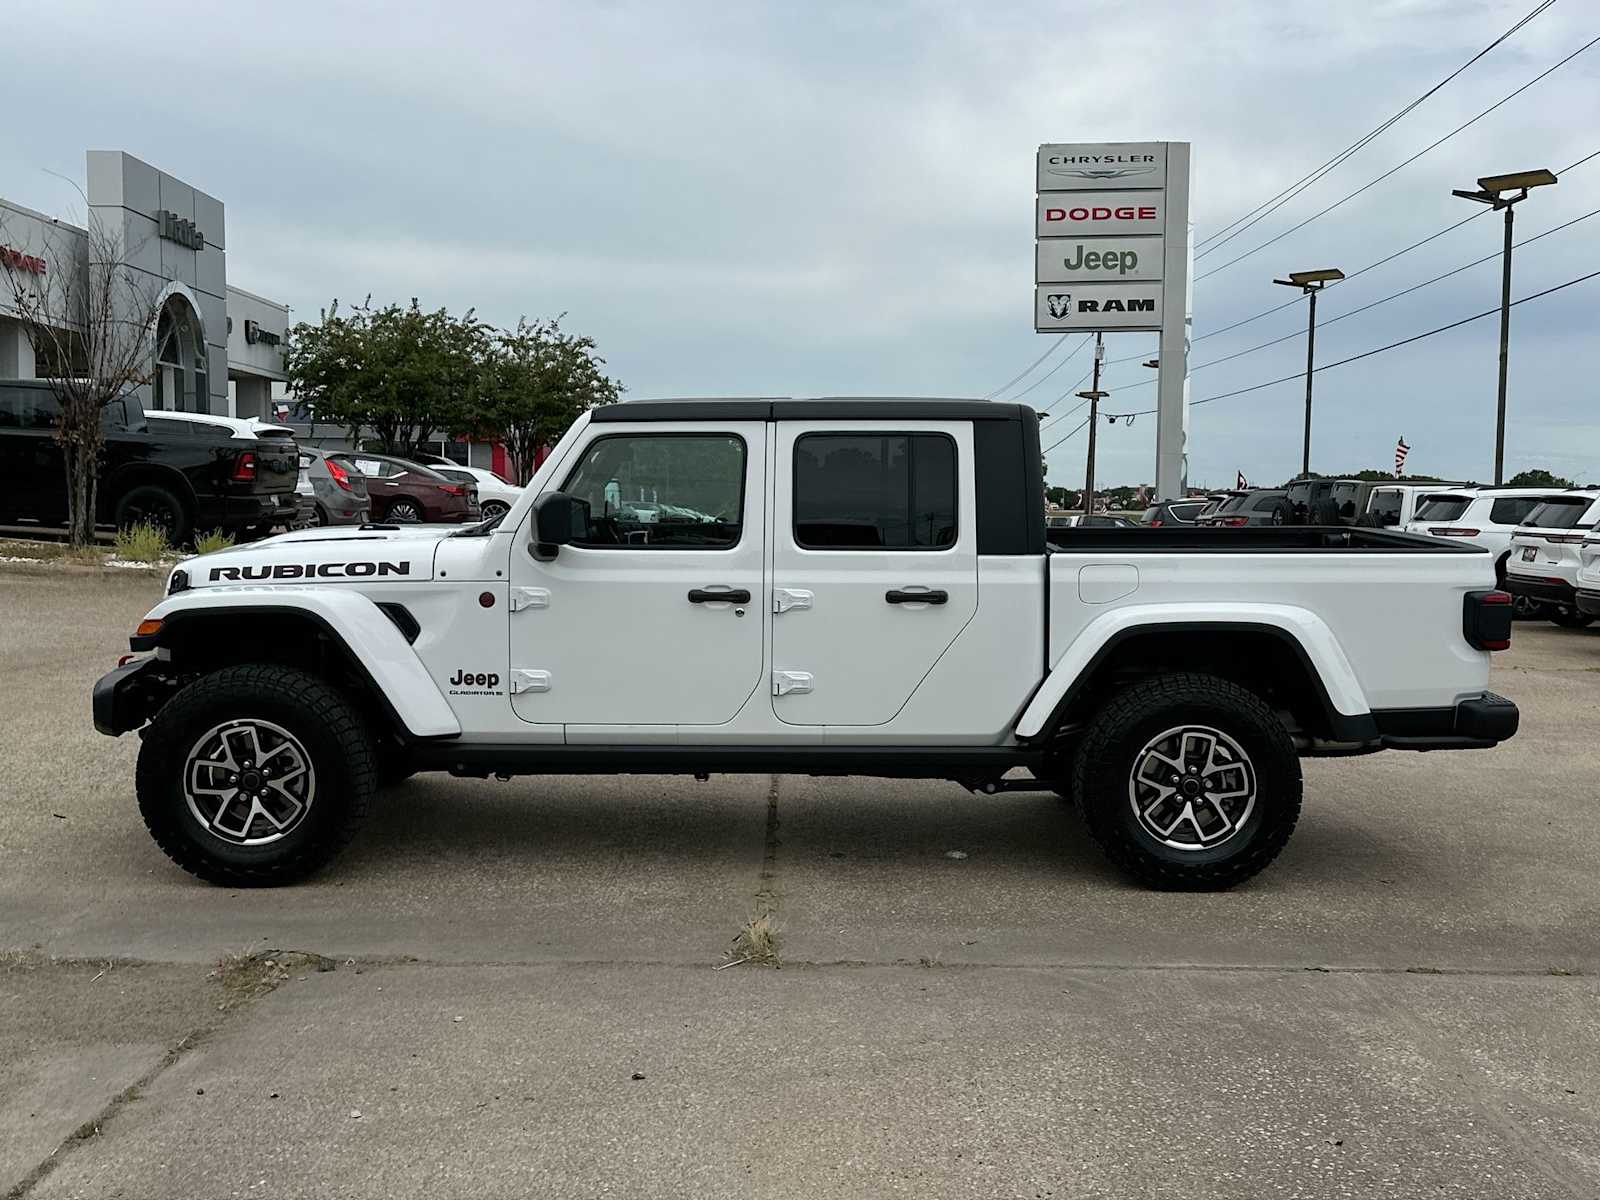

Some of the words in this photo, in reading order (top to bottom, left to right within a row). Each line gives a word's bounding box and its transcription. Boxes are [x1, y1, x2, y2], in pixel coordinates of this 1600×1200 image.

[1049, 155, 1154, 165] CHRYSLER
[1046, 207, 1156, 221] DODGE
[1064, 245, 1137, 275] Jeep
[1078, 299, 1155, 312] RAM
[209, 561, 410, 581] RUBICON
[450, 669, 499, 688] Jeep
